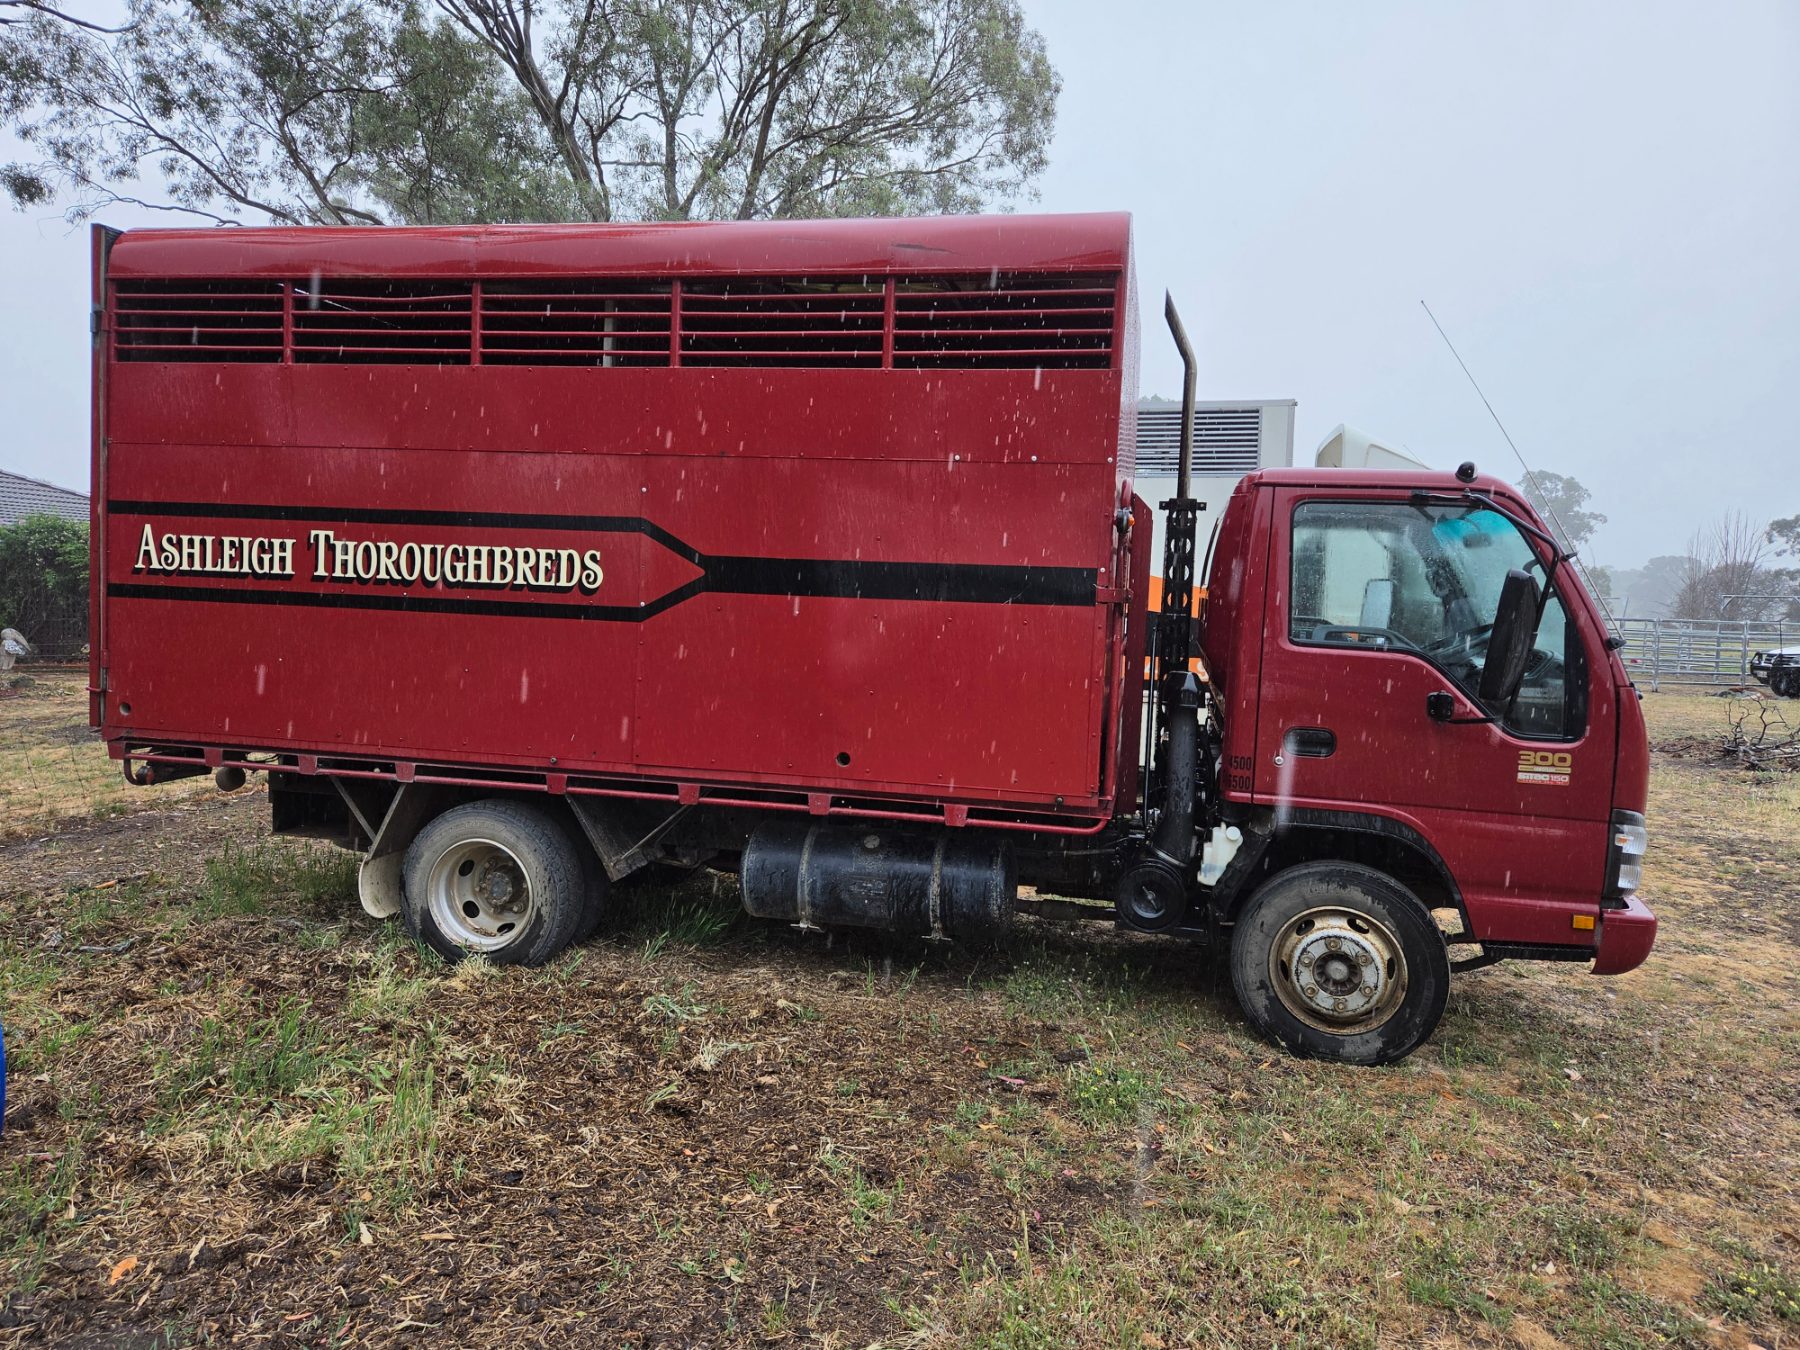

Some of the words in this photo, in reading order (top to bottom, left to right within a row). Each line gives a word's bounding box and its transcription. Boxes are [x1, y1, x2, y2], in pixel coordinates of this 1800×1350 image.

[134, 523, 297, 577] ASHLEIGH
[309, 529, 604, 591] THOROUGHBREDS
[1518, 750, 1572, 767] 300
